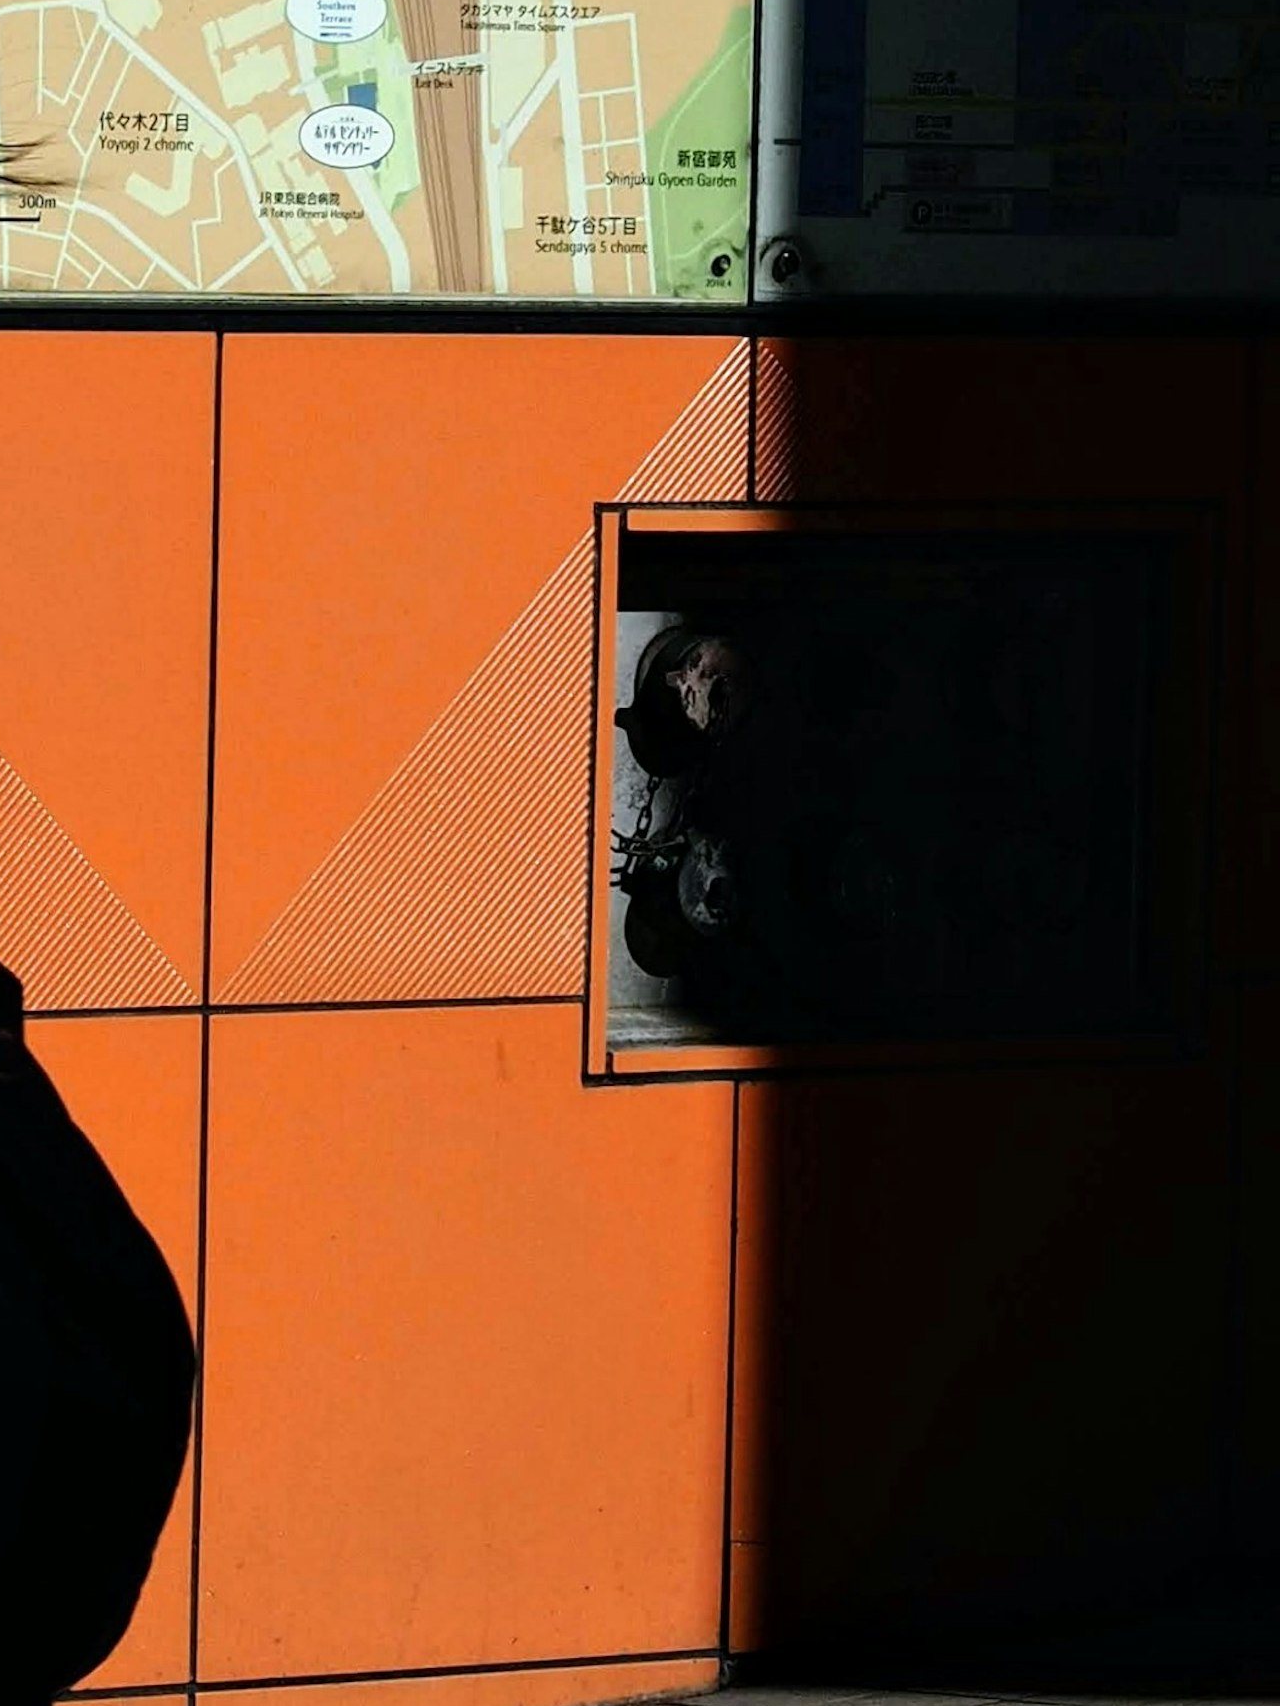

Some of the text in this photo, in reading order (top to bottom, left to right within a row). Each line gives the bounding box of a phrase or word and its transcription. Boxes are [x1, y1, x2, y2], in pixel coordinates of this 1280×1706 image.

[99, 112, 190, 133] 代々木2丁目
[98, 135, 194, 154] Yoyogi 2 chome
[678, 150, 737, 169] 新宿御苑
[605, 173, 737, 188] Shinjuku Gyoen Garden
[18, 194, 57, 210] 300m
[535, 239, 648, 257] Sendagaya 5 chome
